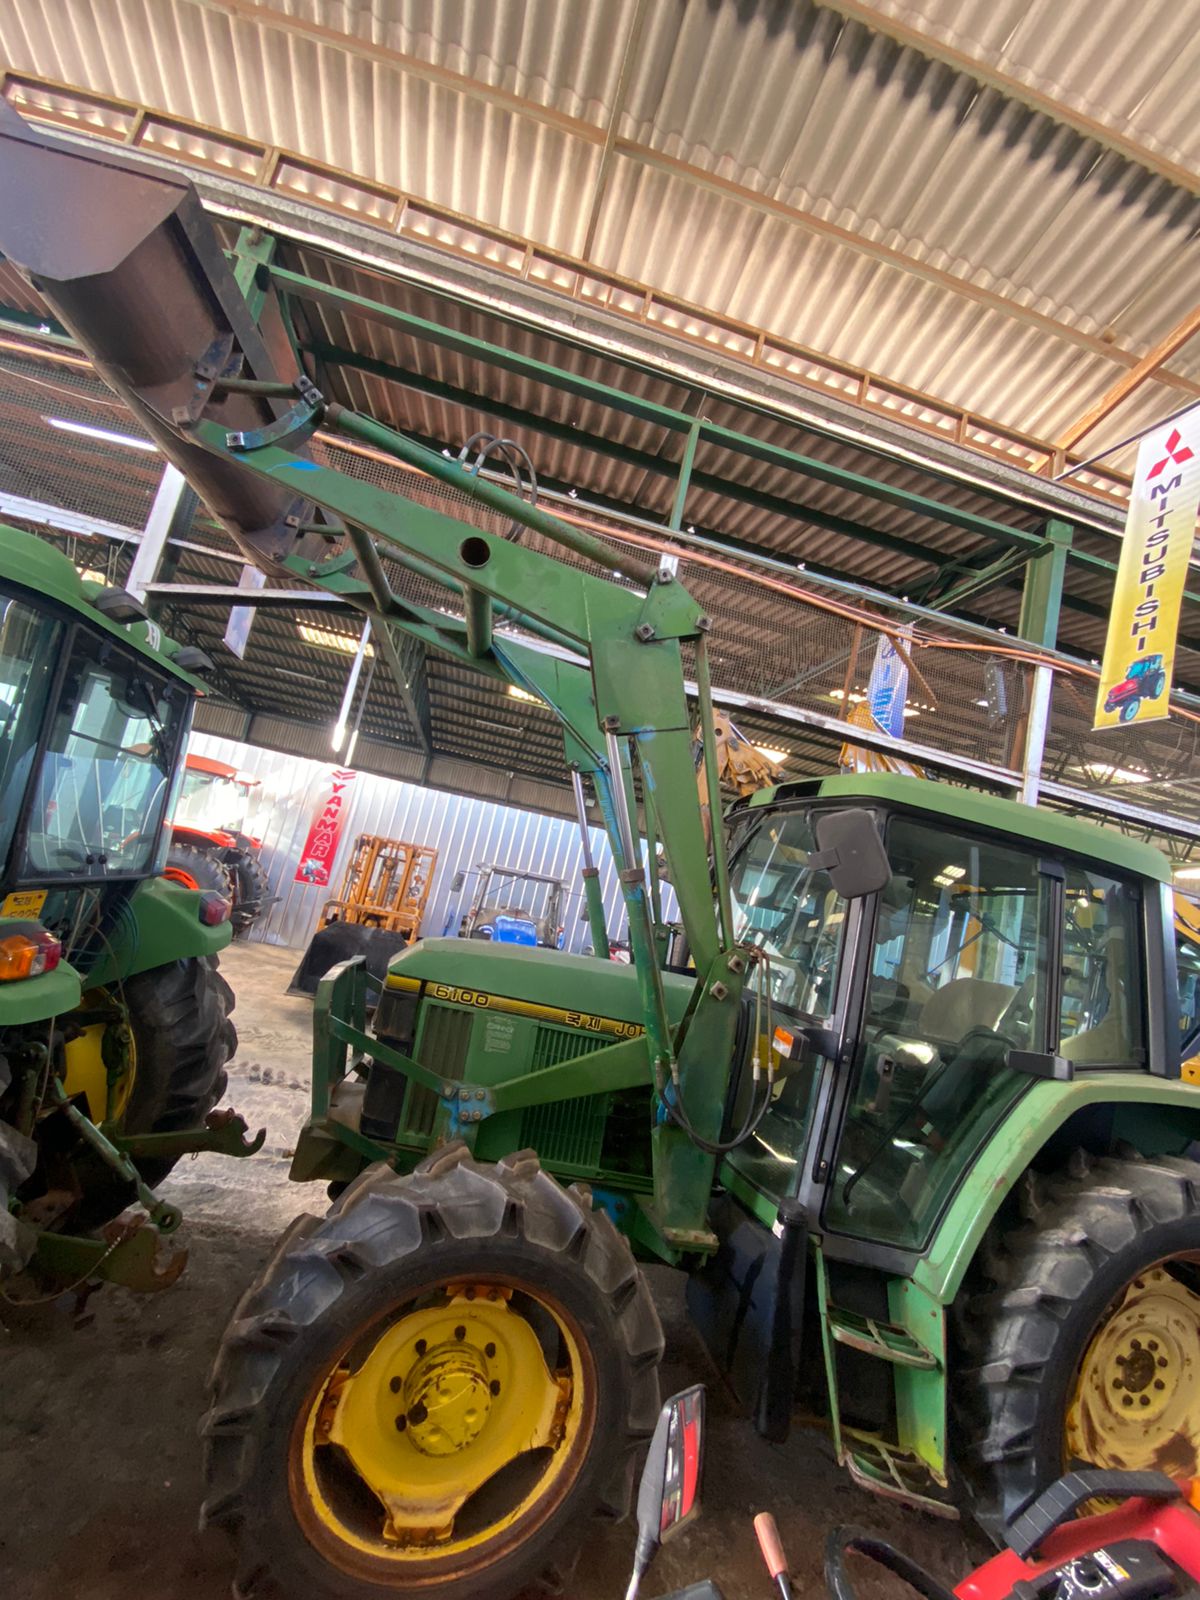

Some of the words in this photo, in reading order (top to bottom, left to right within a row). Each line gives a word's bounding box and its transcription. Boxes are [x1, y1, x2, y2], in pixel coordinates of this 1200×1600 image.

[1131, 473, 1183, 652] MITSUBISHI
[310, 782, 347, 858] YANMAR
[434, 984, 490, 1007] 6100
